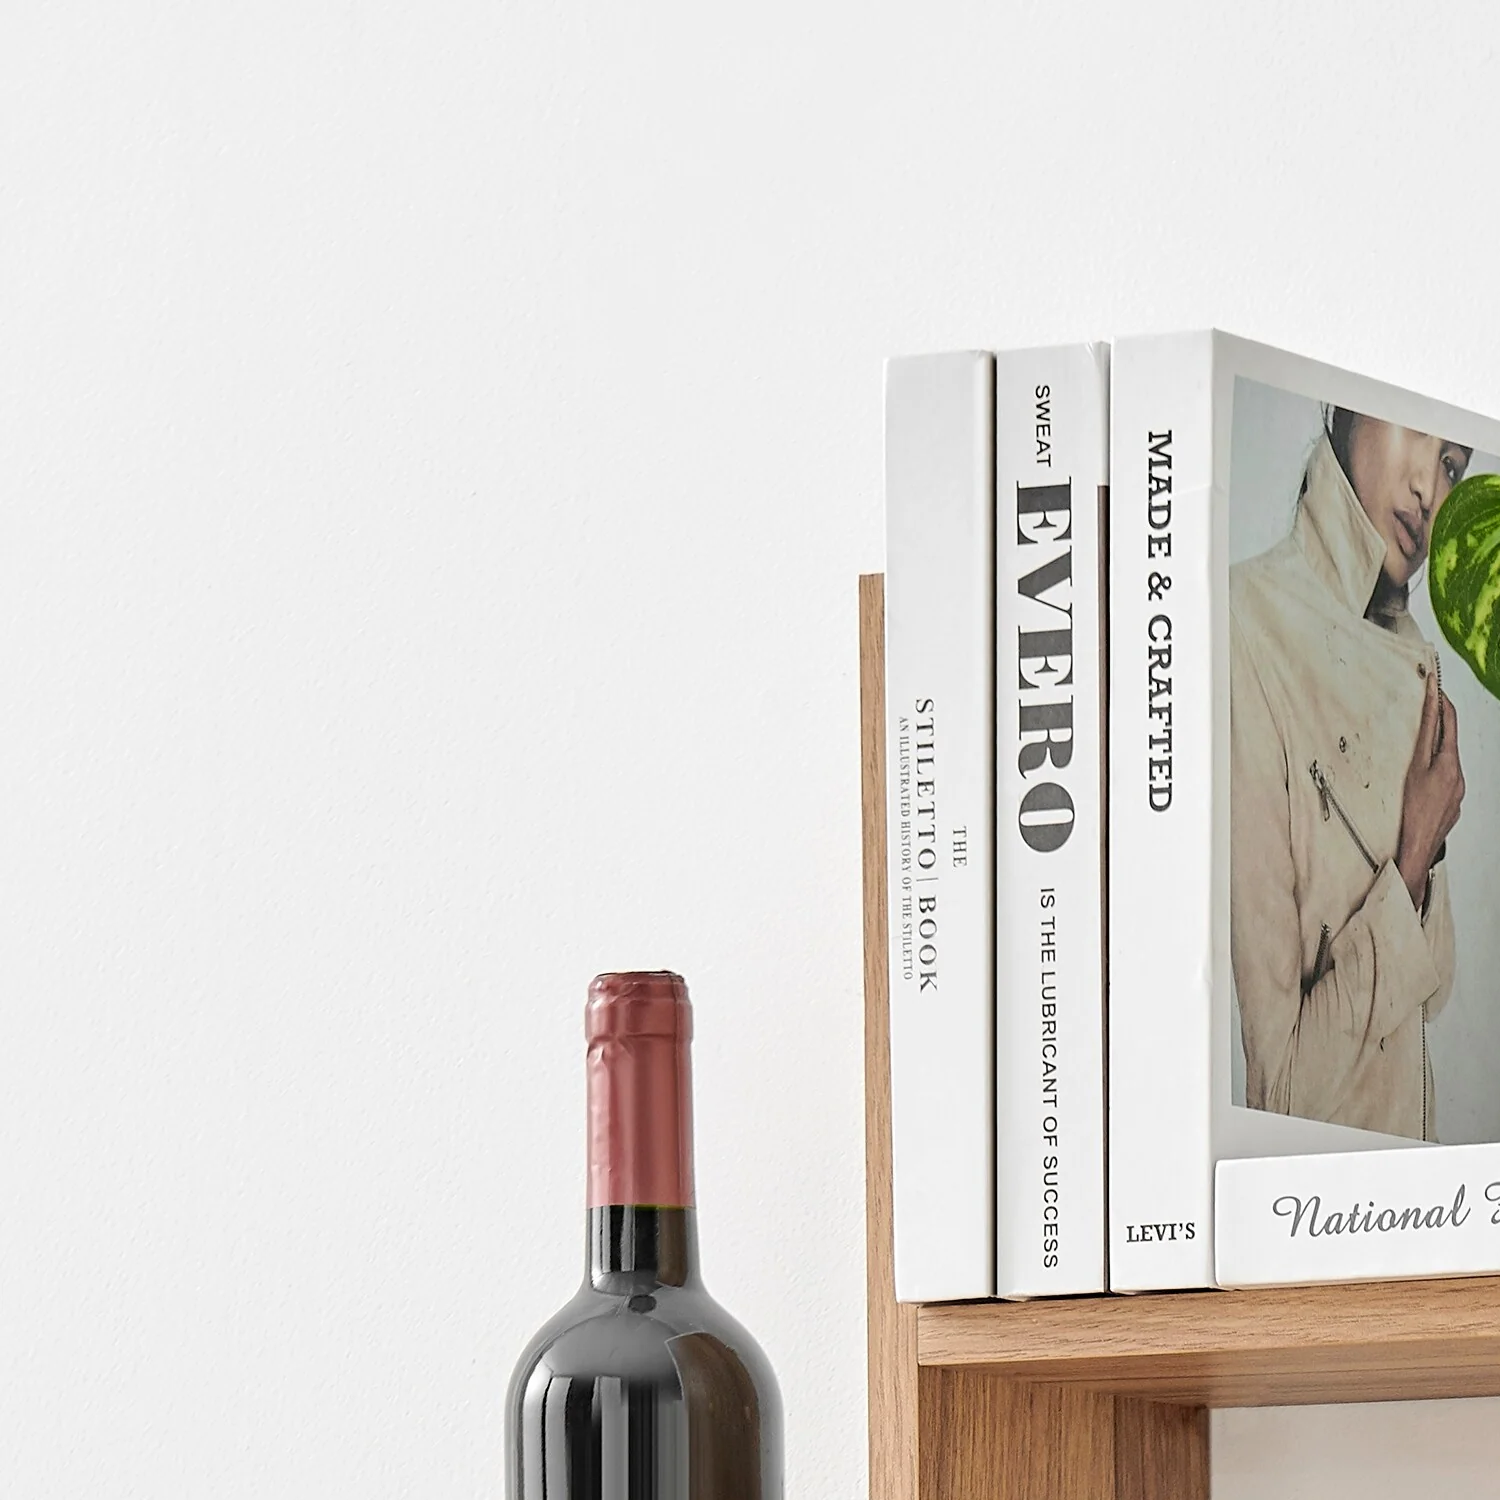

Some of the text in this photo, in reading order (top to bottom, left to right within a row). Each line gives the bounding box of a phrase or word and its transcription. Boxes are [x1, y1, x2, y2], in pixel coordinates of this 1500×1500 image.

[1147, 429, 1173, 813] MADE & CRAFTED
[898, 716, 914, 980] AN ILLUSTRATED HISTORY OF THE STILETTO
[915, 698, 938, 992] STILETTO BOOK
[952, 825, 968, 868] THE
[1016, 384, 1076, 1269] SWEAT EVERO IS THE LUBRICANT OF SUCCESS
[1126, 1222, 1196, 1243] LEVI'S
[1272, 1183, 1472, 1239] National
